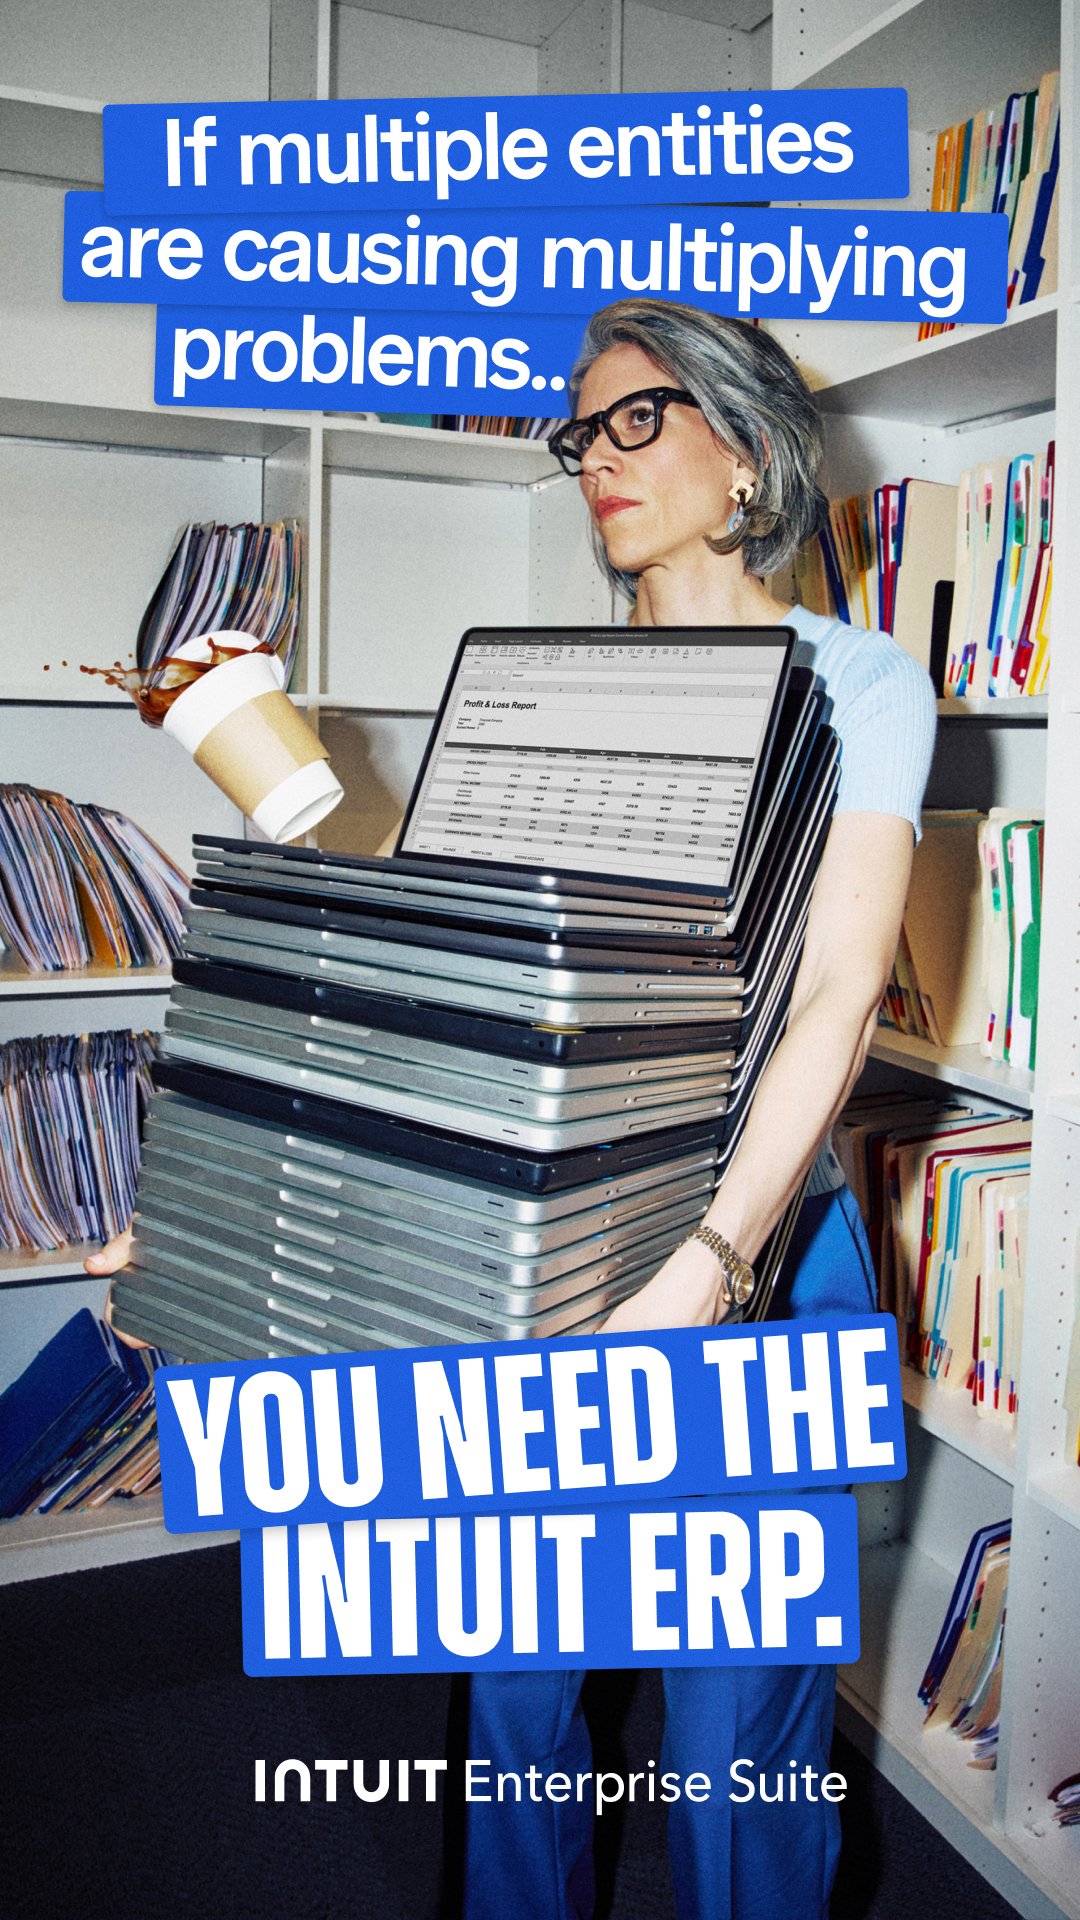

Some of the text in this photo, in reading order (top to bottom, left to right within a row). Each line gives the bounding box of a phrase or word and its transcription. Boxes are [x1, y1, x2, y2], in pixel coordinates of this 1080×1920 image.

[463, 699, 537, 711] Profit & Loss Report
